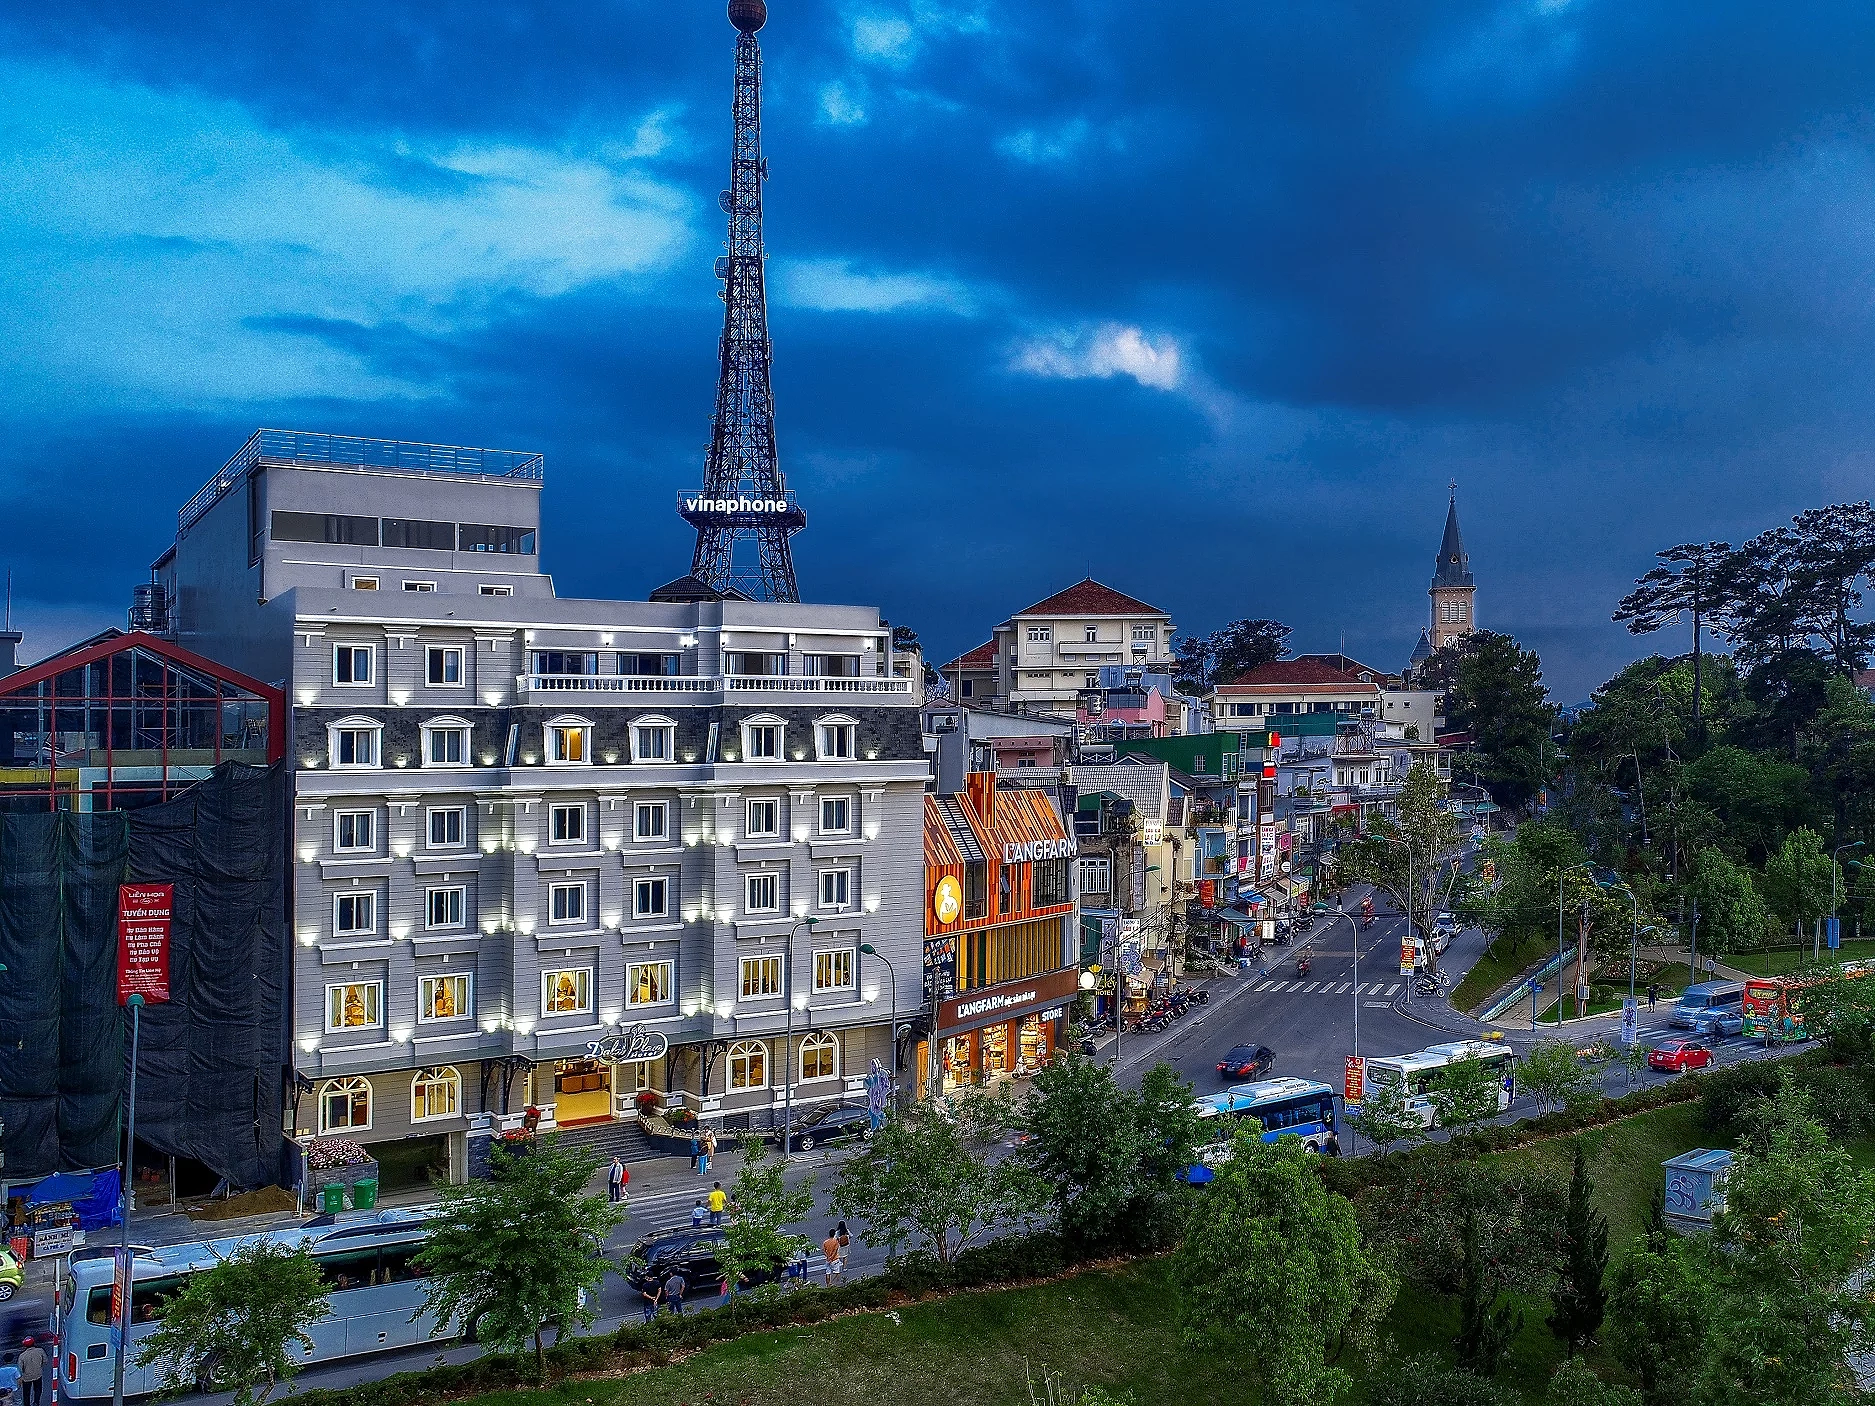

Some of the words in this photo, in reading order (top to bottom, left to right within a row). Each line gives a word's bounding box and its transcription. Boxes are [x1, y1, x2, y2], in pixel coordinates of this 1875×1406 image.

[686, 495, 788, 515] vinaphone
[1003, 838, 1078, 863] L'ANGFARM
[148, 908, 170, 918] DỤNG
[957, 995, 1005, 1019] L'ANGFARM
[1041, 1007, 1063, 1021] STORE
